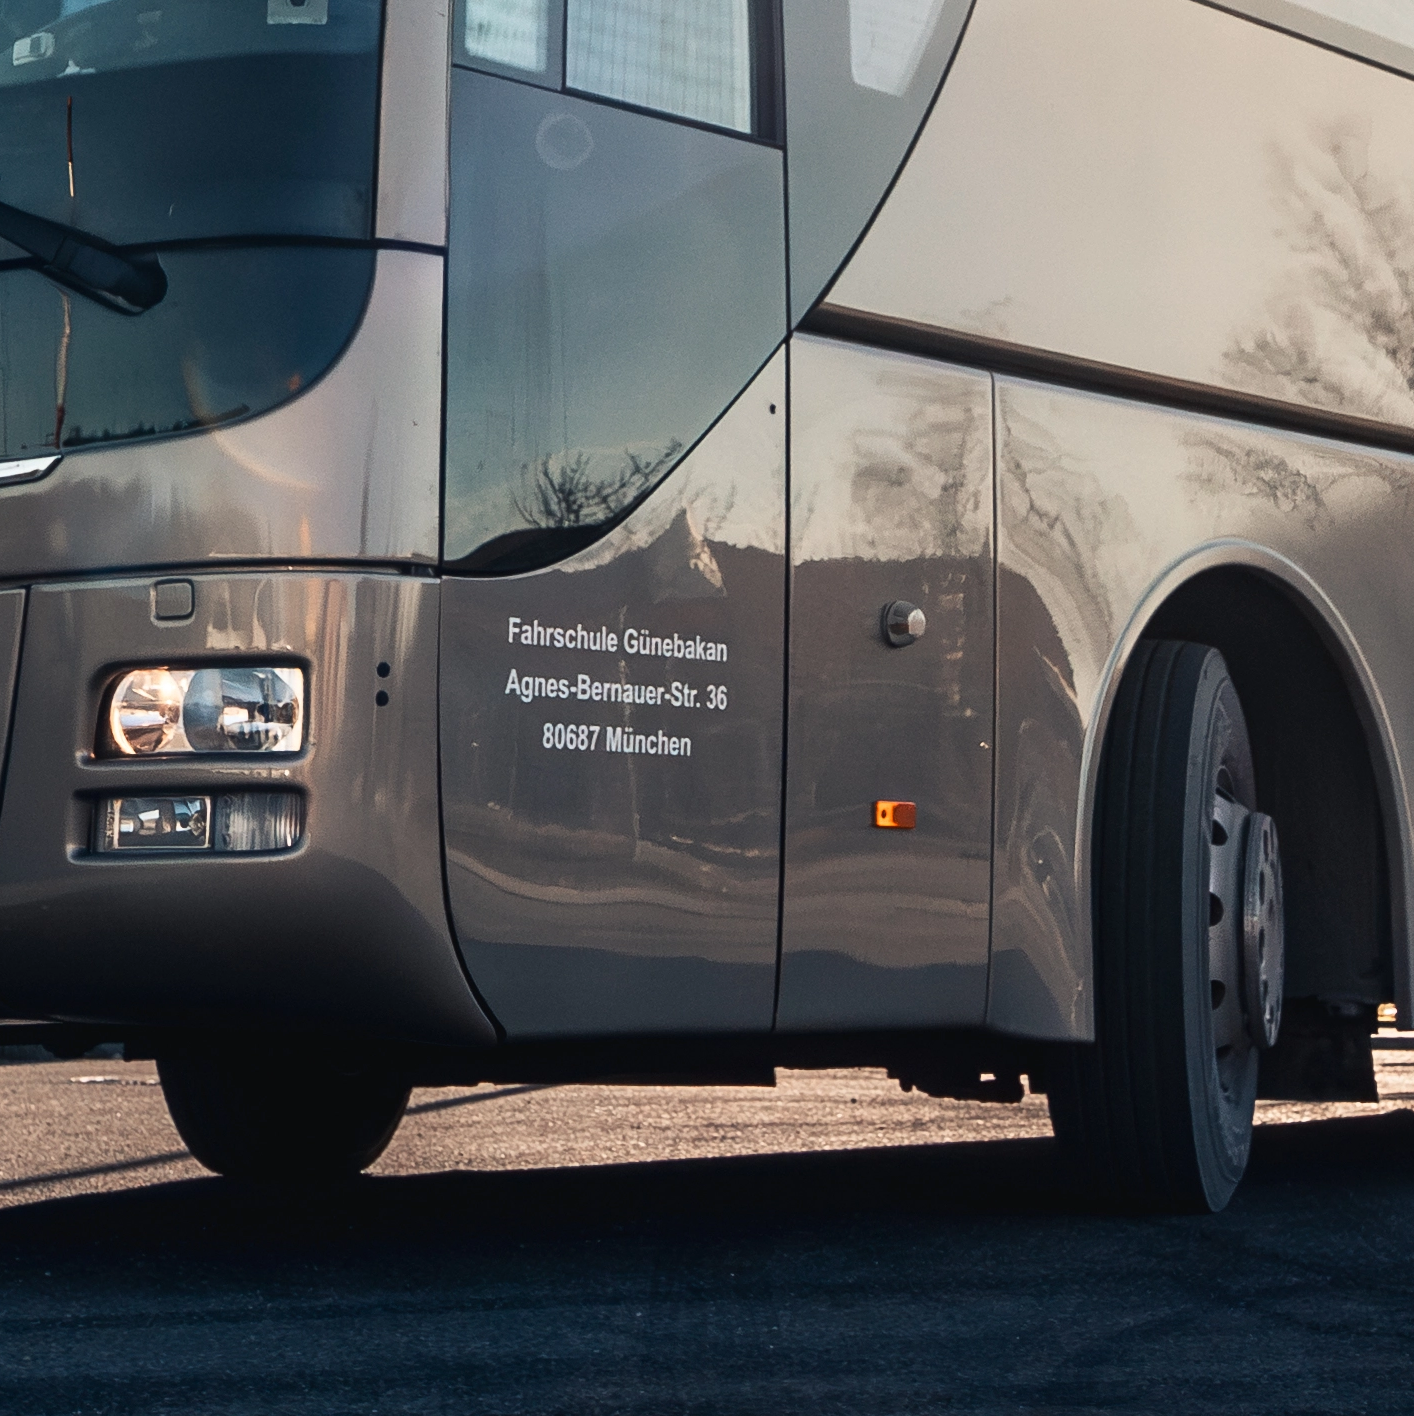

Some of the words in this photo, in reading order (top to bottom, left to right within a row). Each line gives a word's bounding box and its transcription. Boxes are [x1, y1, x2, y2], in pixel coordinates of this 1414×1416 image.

[508, 617, 618, 652] Fahrschule
[624, 628, 728, 662] Günebakan
[505, 668, 701, 708] Agnes-Bernauer-Str.
[706, 685, 728, 710] 36
[542, 723, 600, 751] 80687
[606, 727, 692, 756] München
